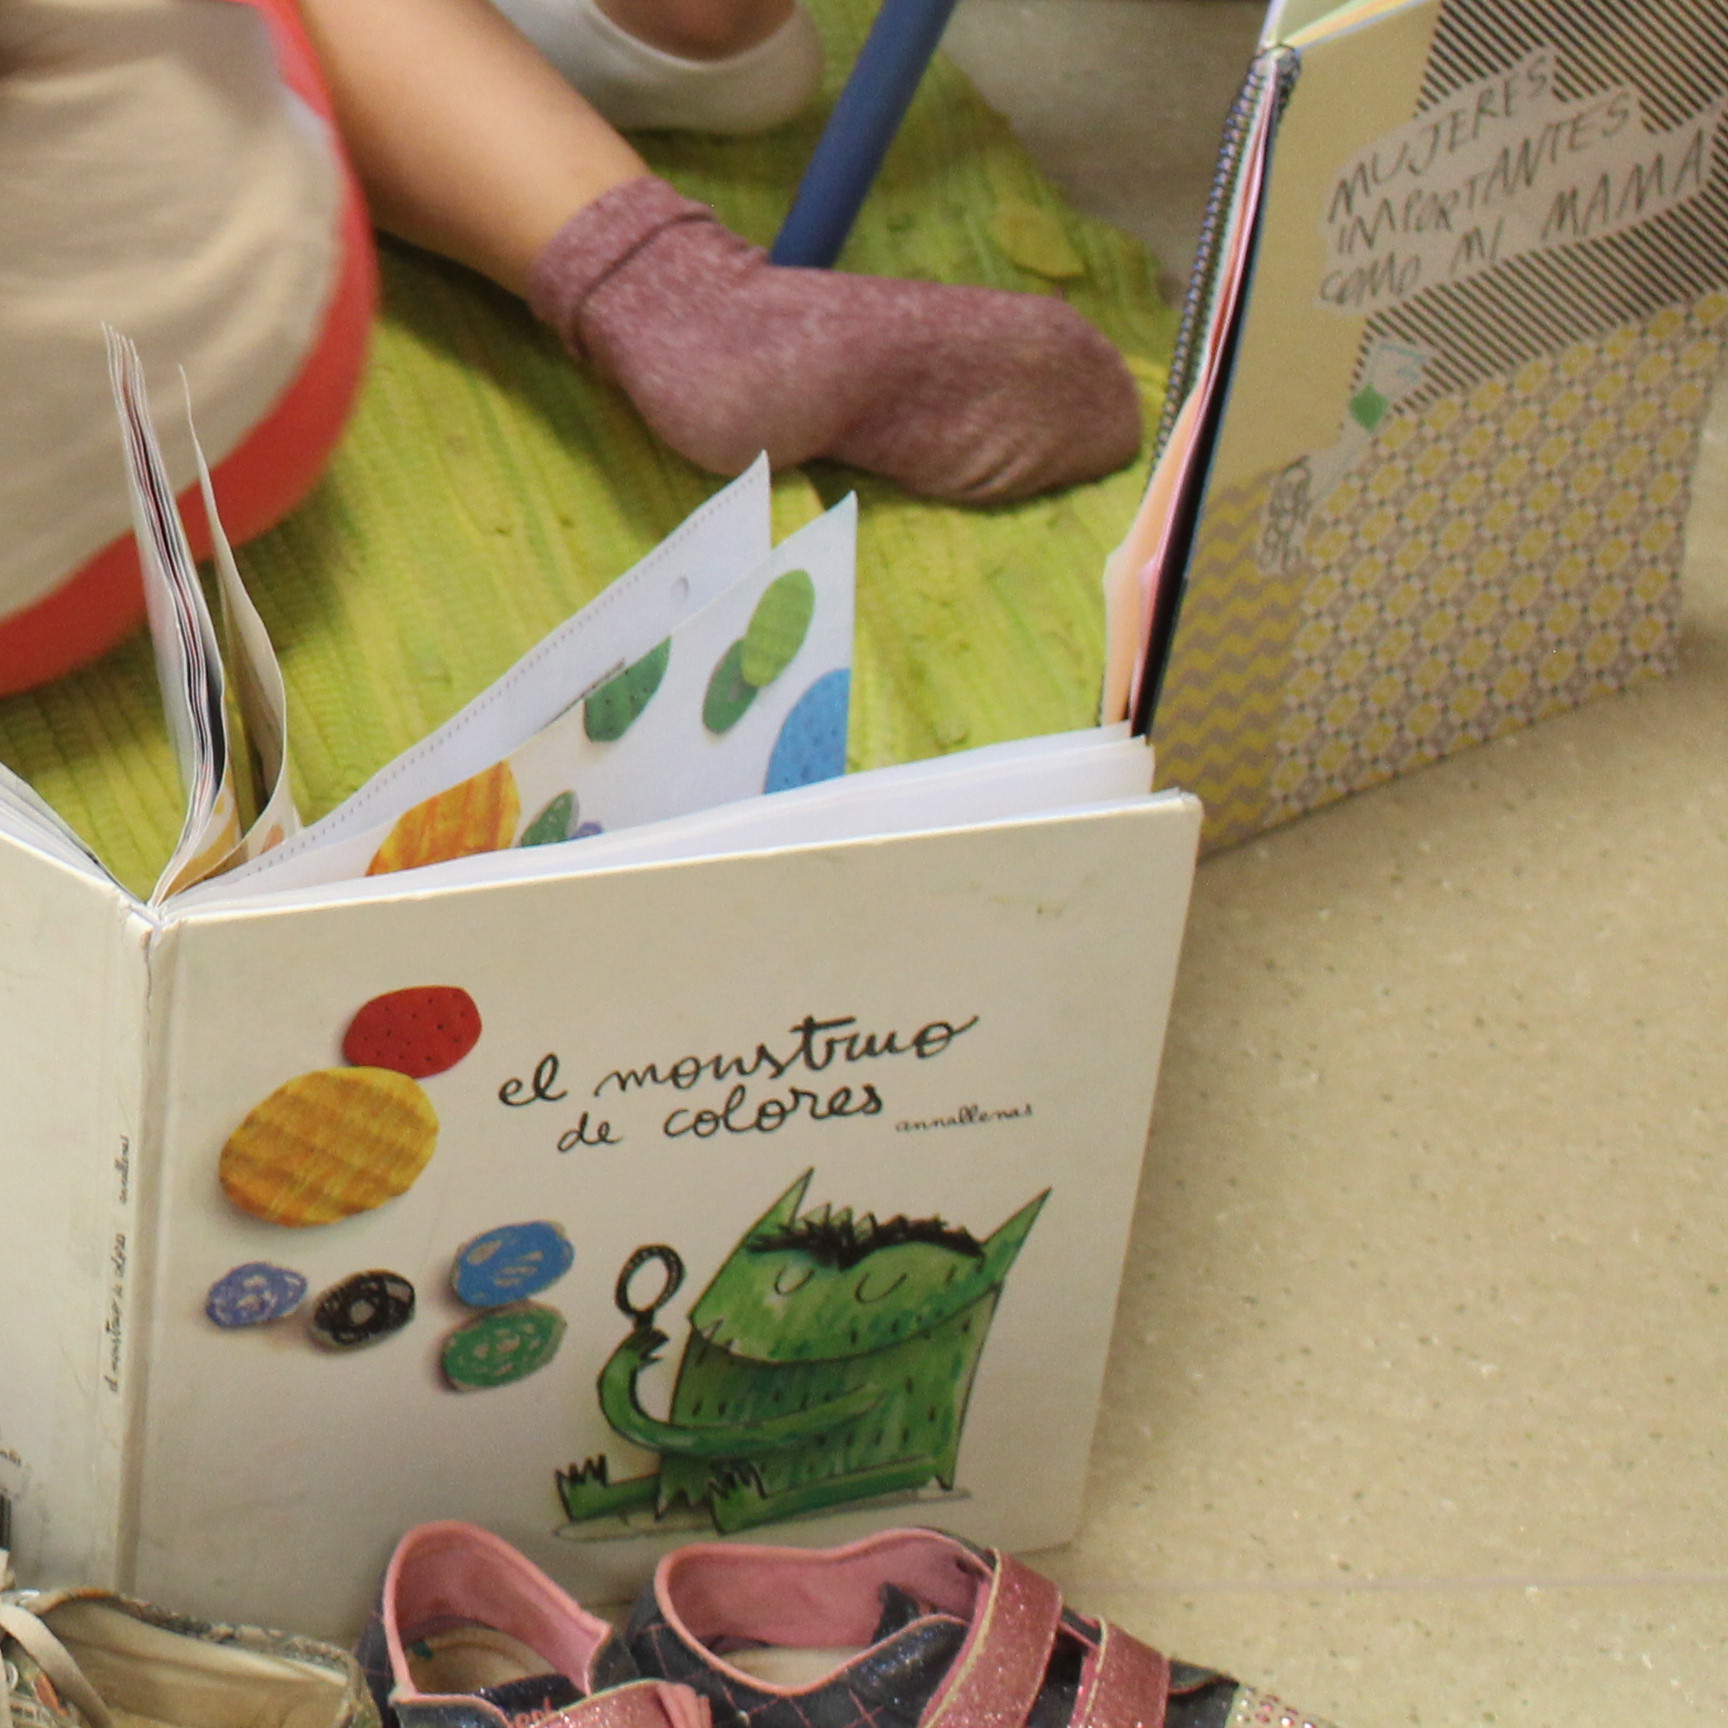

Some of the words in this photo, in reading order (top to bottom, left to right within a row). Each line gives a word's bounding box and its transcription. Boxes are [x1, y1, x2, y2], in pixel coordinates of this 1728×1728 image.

[1328, 54, 1548, 225] MUJERES
[1338, 90, 1630, 256] IMPORTANTES
[1320, 251, 1421, 308] COMO
[1451, 216, 1504, 277] MI
[499, 1051, 568, 1107] el
[594, 1014, 980, 1097] monstruo
[555, 1111, 625, 1153] de
[662, 1082, 884, 1138] colores
